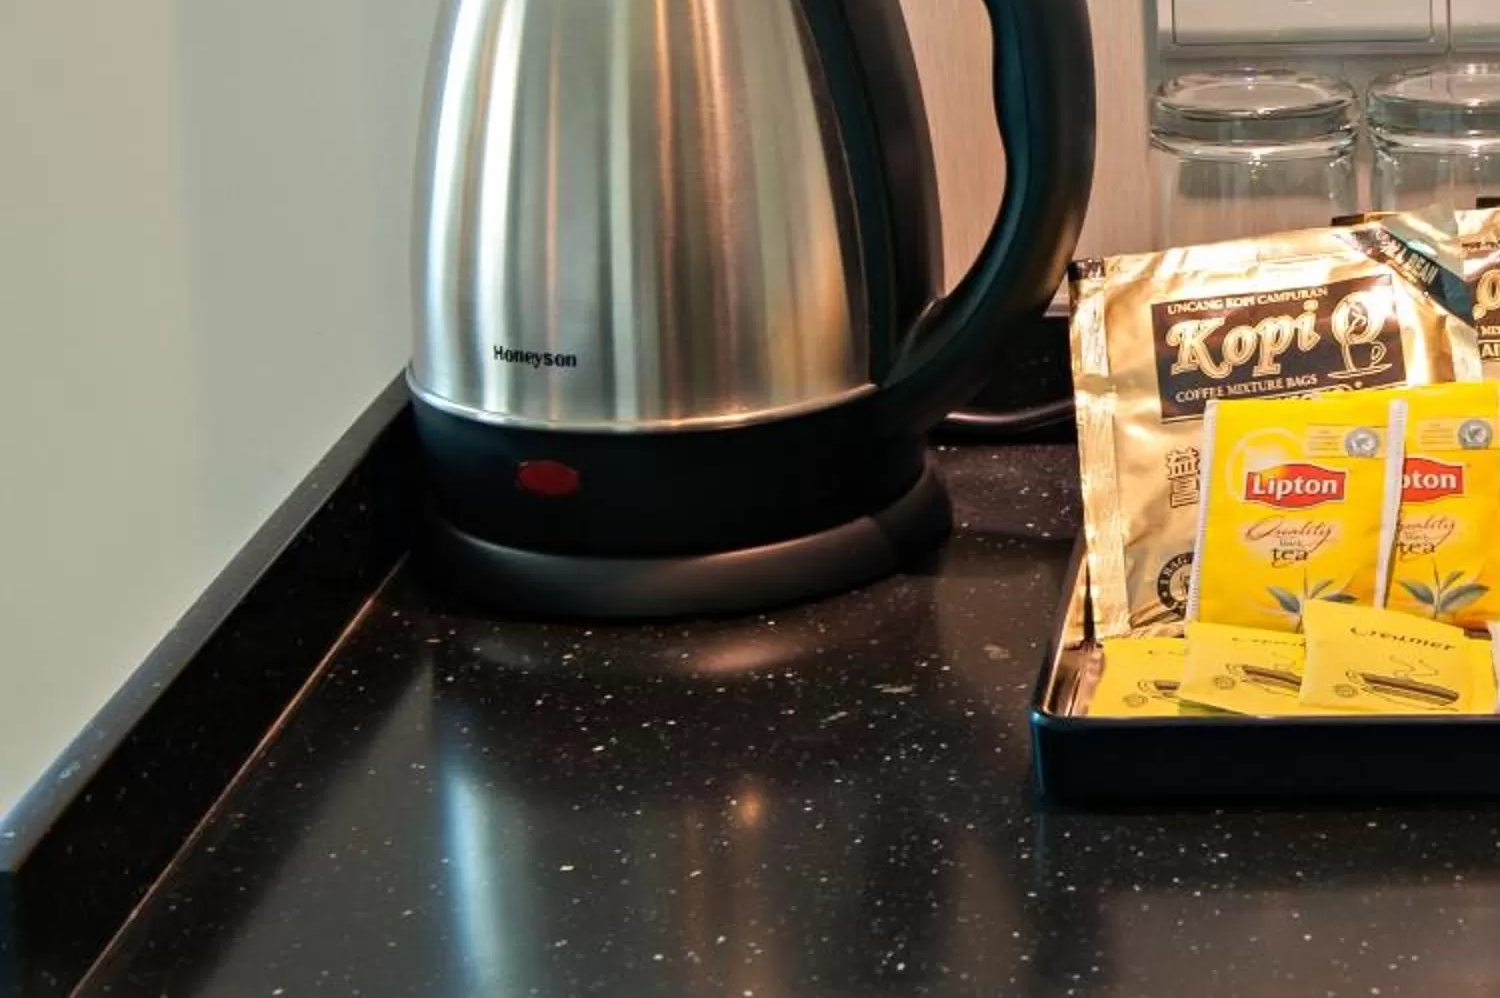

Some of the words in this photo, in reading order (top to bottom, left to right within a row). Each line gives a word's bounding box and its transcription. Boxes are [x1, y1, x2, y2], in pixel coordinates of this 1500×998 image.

[1167, 297, 1224, 315] UNCANG
[1257, 286, 1329, 305] CAMPURAN
[1165, 299, 1321, 379] Kopi
[493, 345, 578, 370] Honeyson
[1175, 386, 1225, 403] COFFEE
[1227, 379, 1284, 397] MIXTURE
[1286, 373, 1318, 388] BAGS
[1252, 474, 1338, 500] Lipton
[1271, 548, 1309, 564] tea
